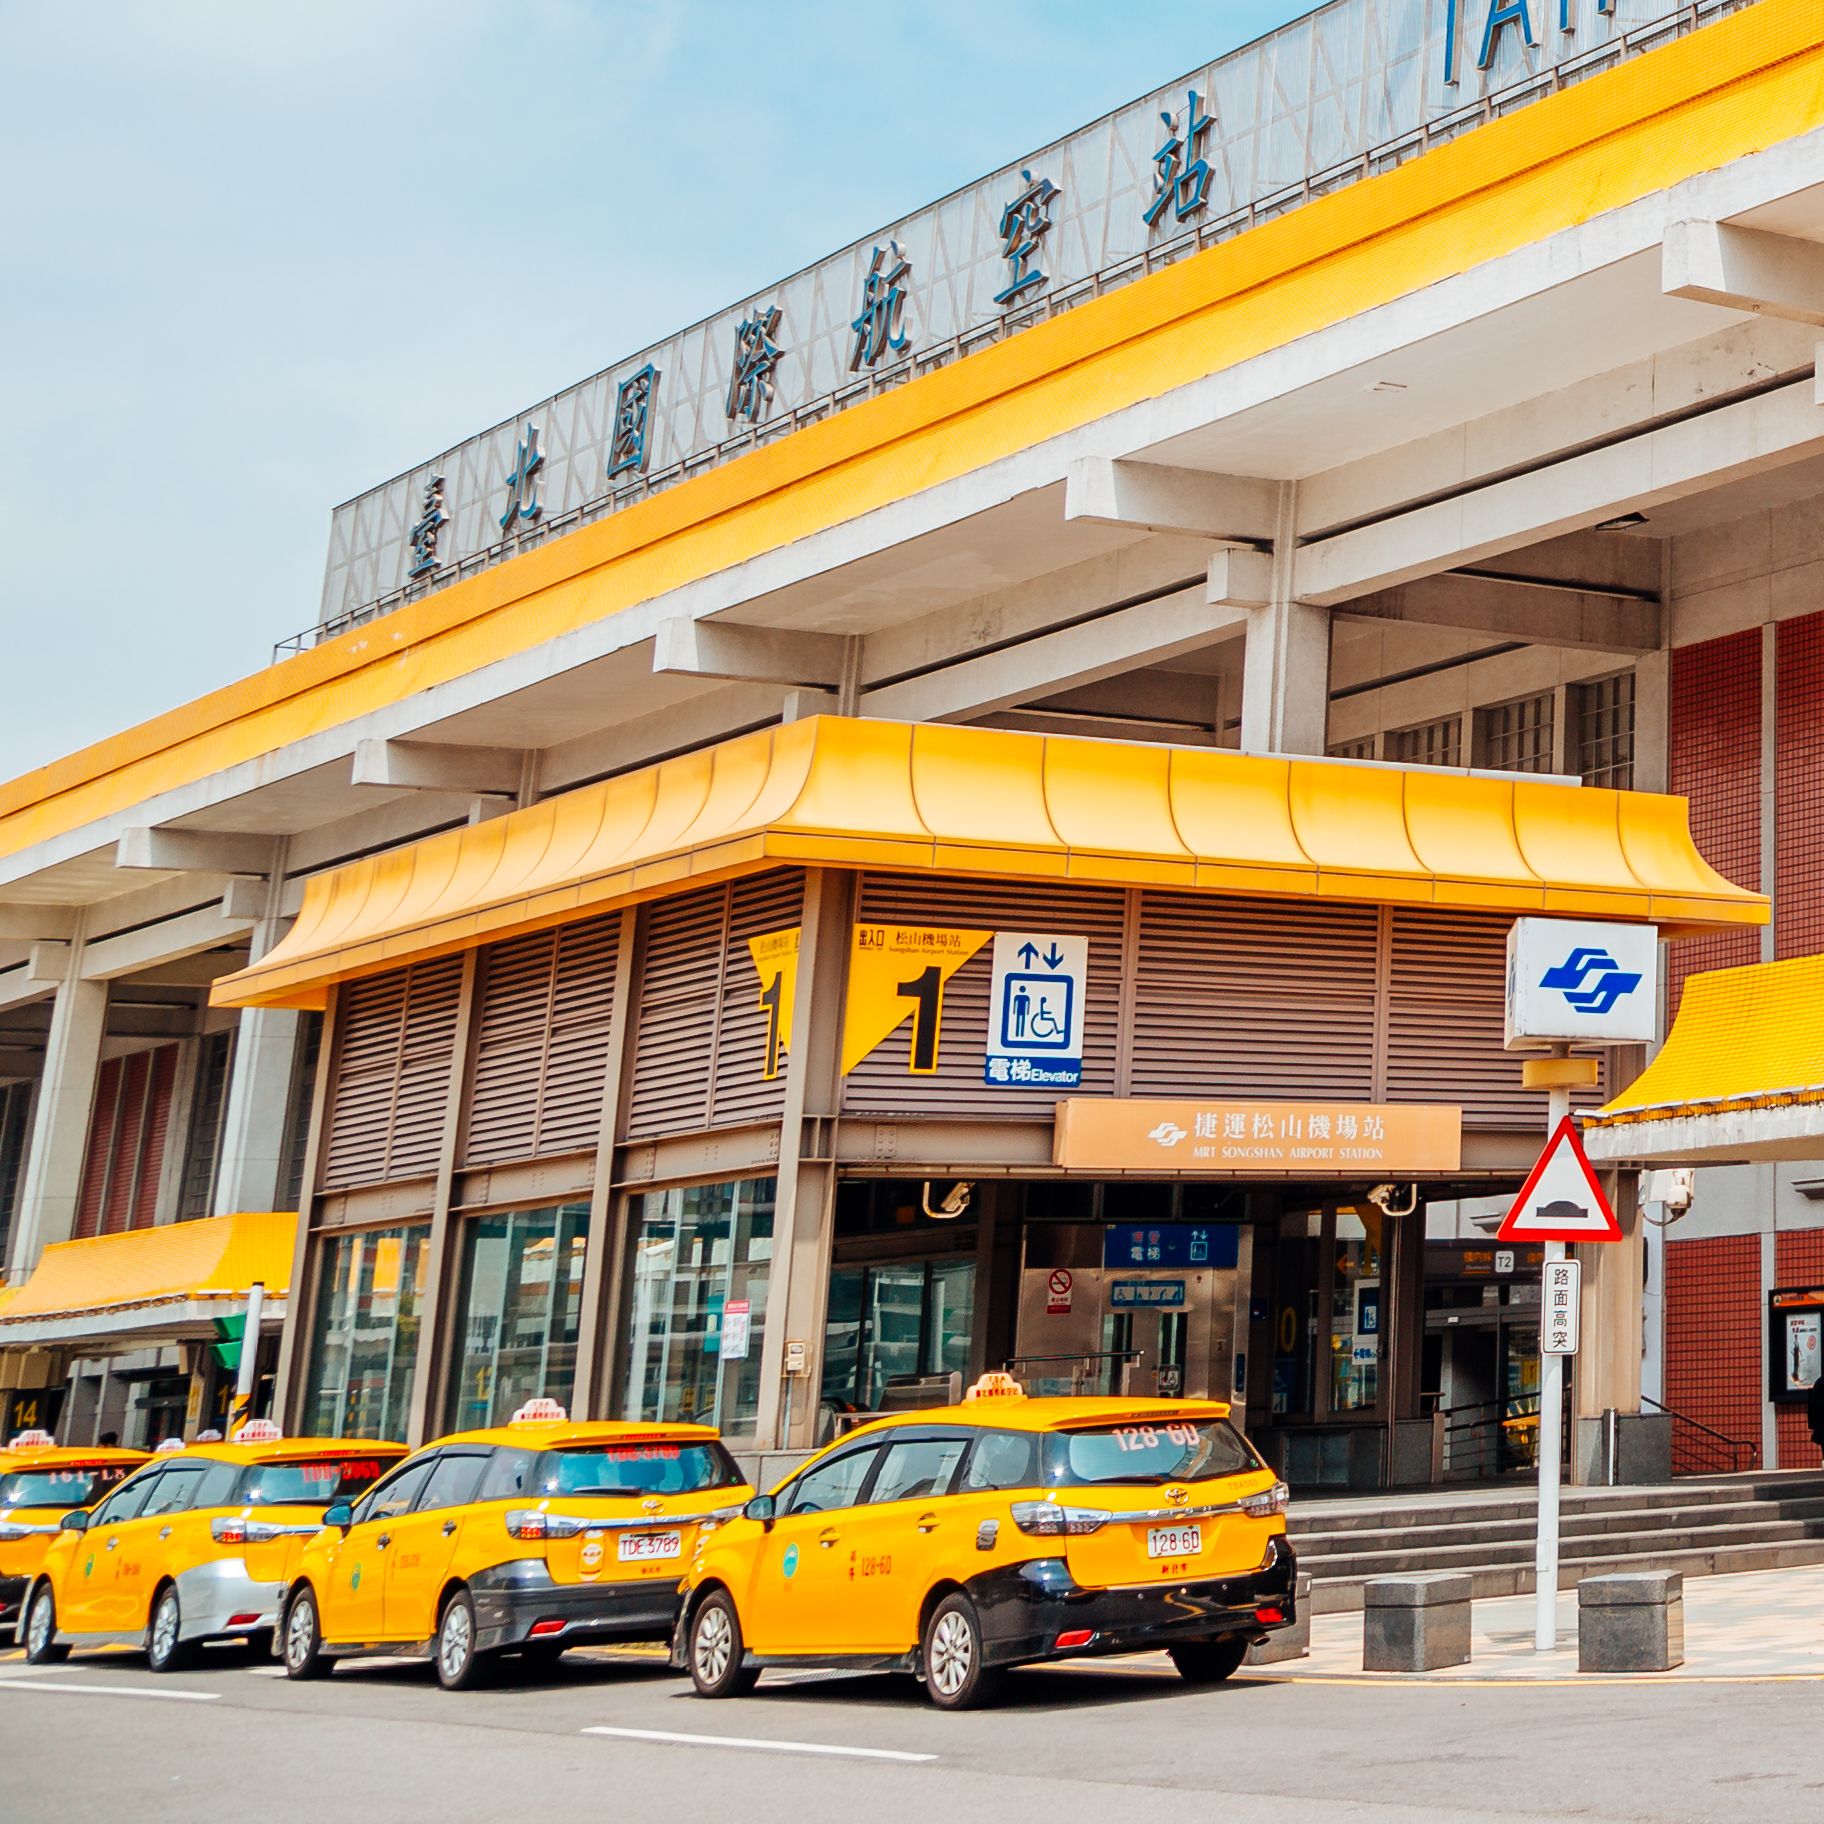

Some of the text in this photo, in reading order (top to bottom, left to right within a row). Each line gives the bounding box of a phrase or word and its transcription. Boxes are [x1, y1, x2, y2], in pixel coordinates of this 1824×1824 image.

[408, 91, 1217, 578] 臺北國際航空站
[859, 929, 961, 947] 出入口 松山機場站
[762, 971, 782, 1075] 1
[897, 966, 942, 1069] 1
[989, 1058, 1077, 1083] 電梯 Elevator
[1194, 1112, 1385, 1140] 捷運松山機場站
[1193, 1146, 1383, 1159] MRT SONGSHAN AIRPORT STATION
[1497, 1256, 1511, 1267] T2
[1552, 1268, 1569, 1348] 路面高突
[15, 1400, 37, 1427] 14
[1112, 1423, 1200, 1452] 128-6D
